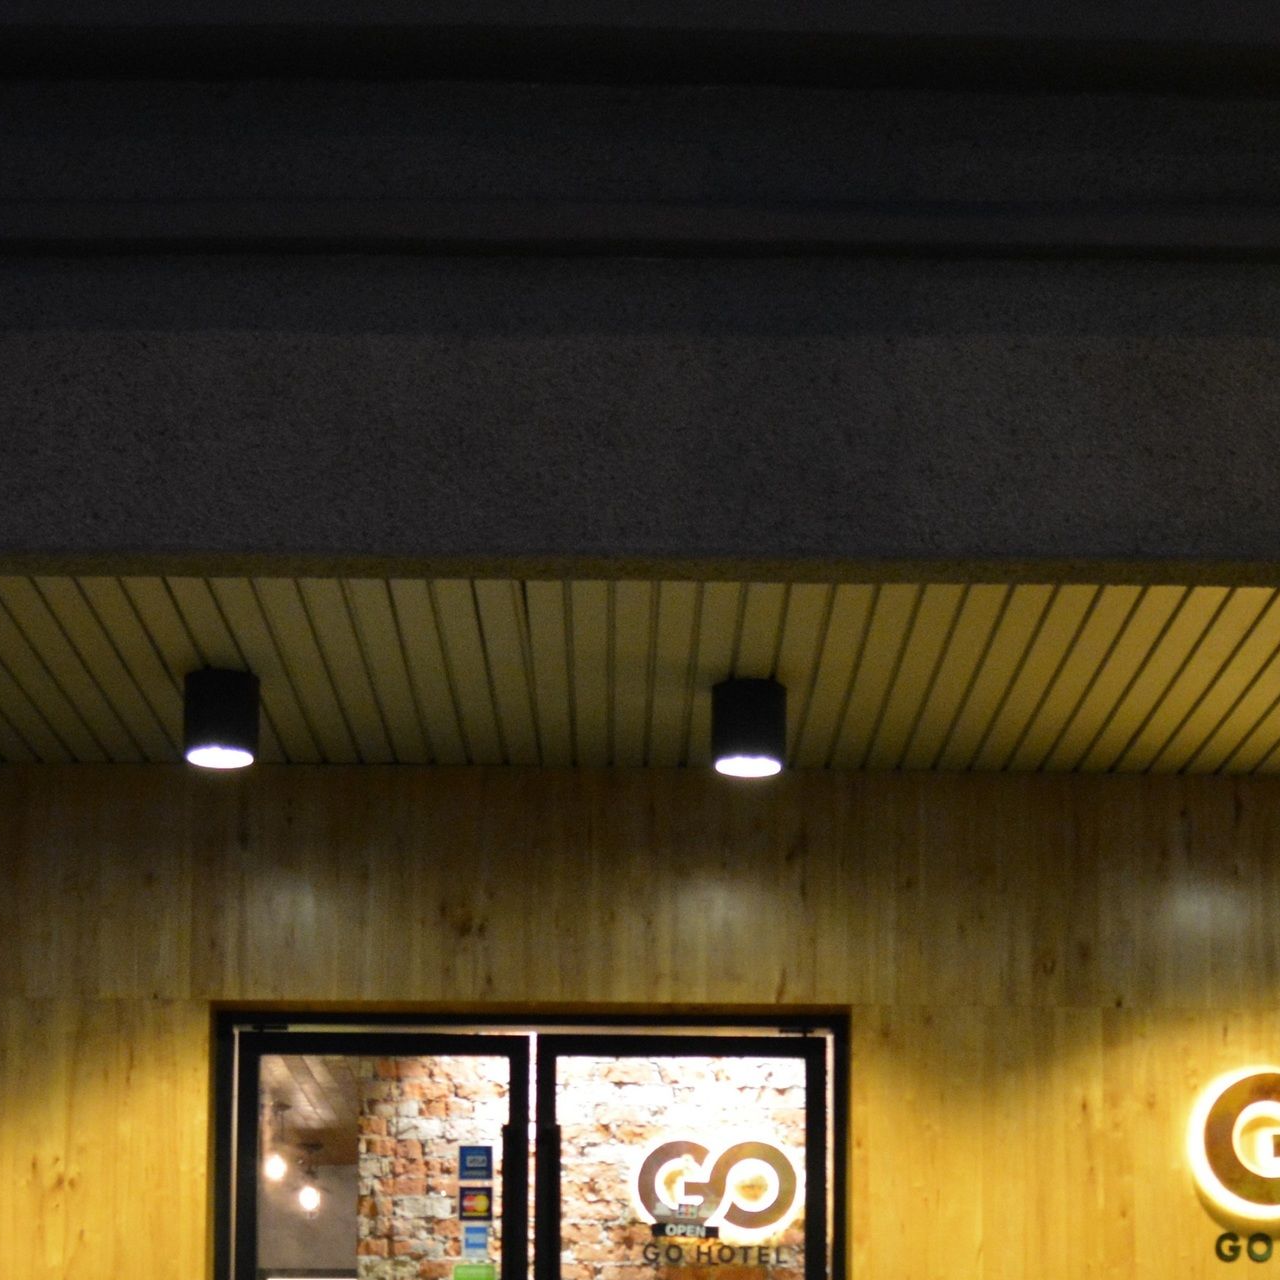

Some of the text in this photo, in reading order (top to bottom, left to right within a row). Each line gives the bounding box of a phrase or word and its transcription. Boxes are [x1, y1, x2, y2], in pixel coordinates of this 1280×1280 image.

[638, 1140, 797, 1228] GO
[665, 1223, 707, 1238] OPEN
[643, 1244, 788, 1264] GO HOTEL
[1215, 1232, 1273, 1264] GO
